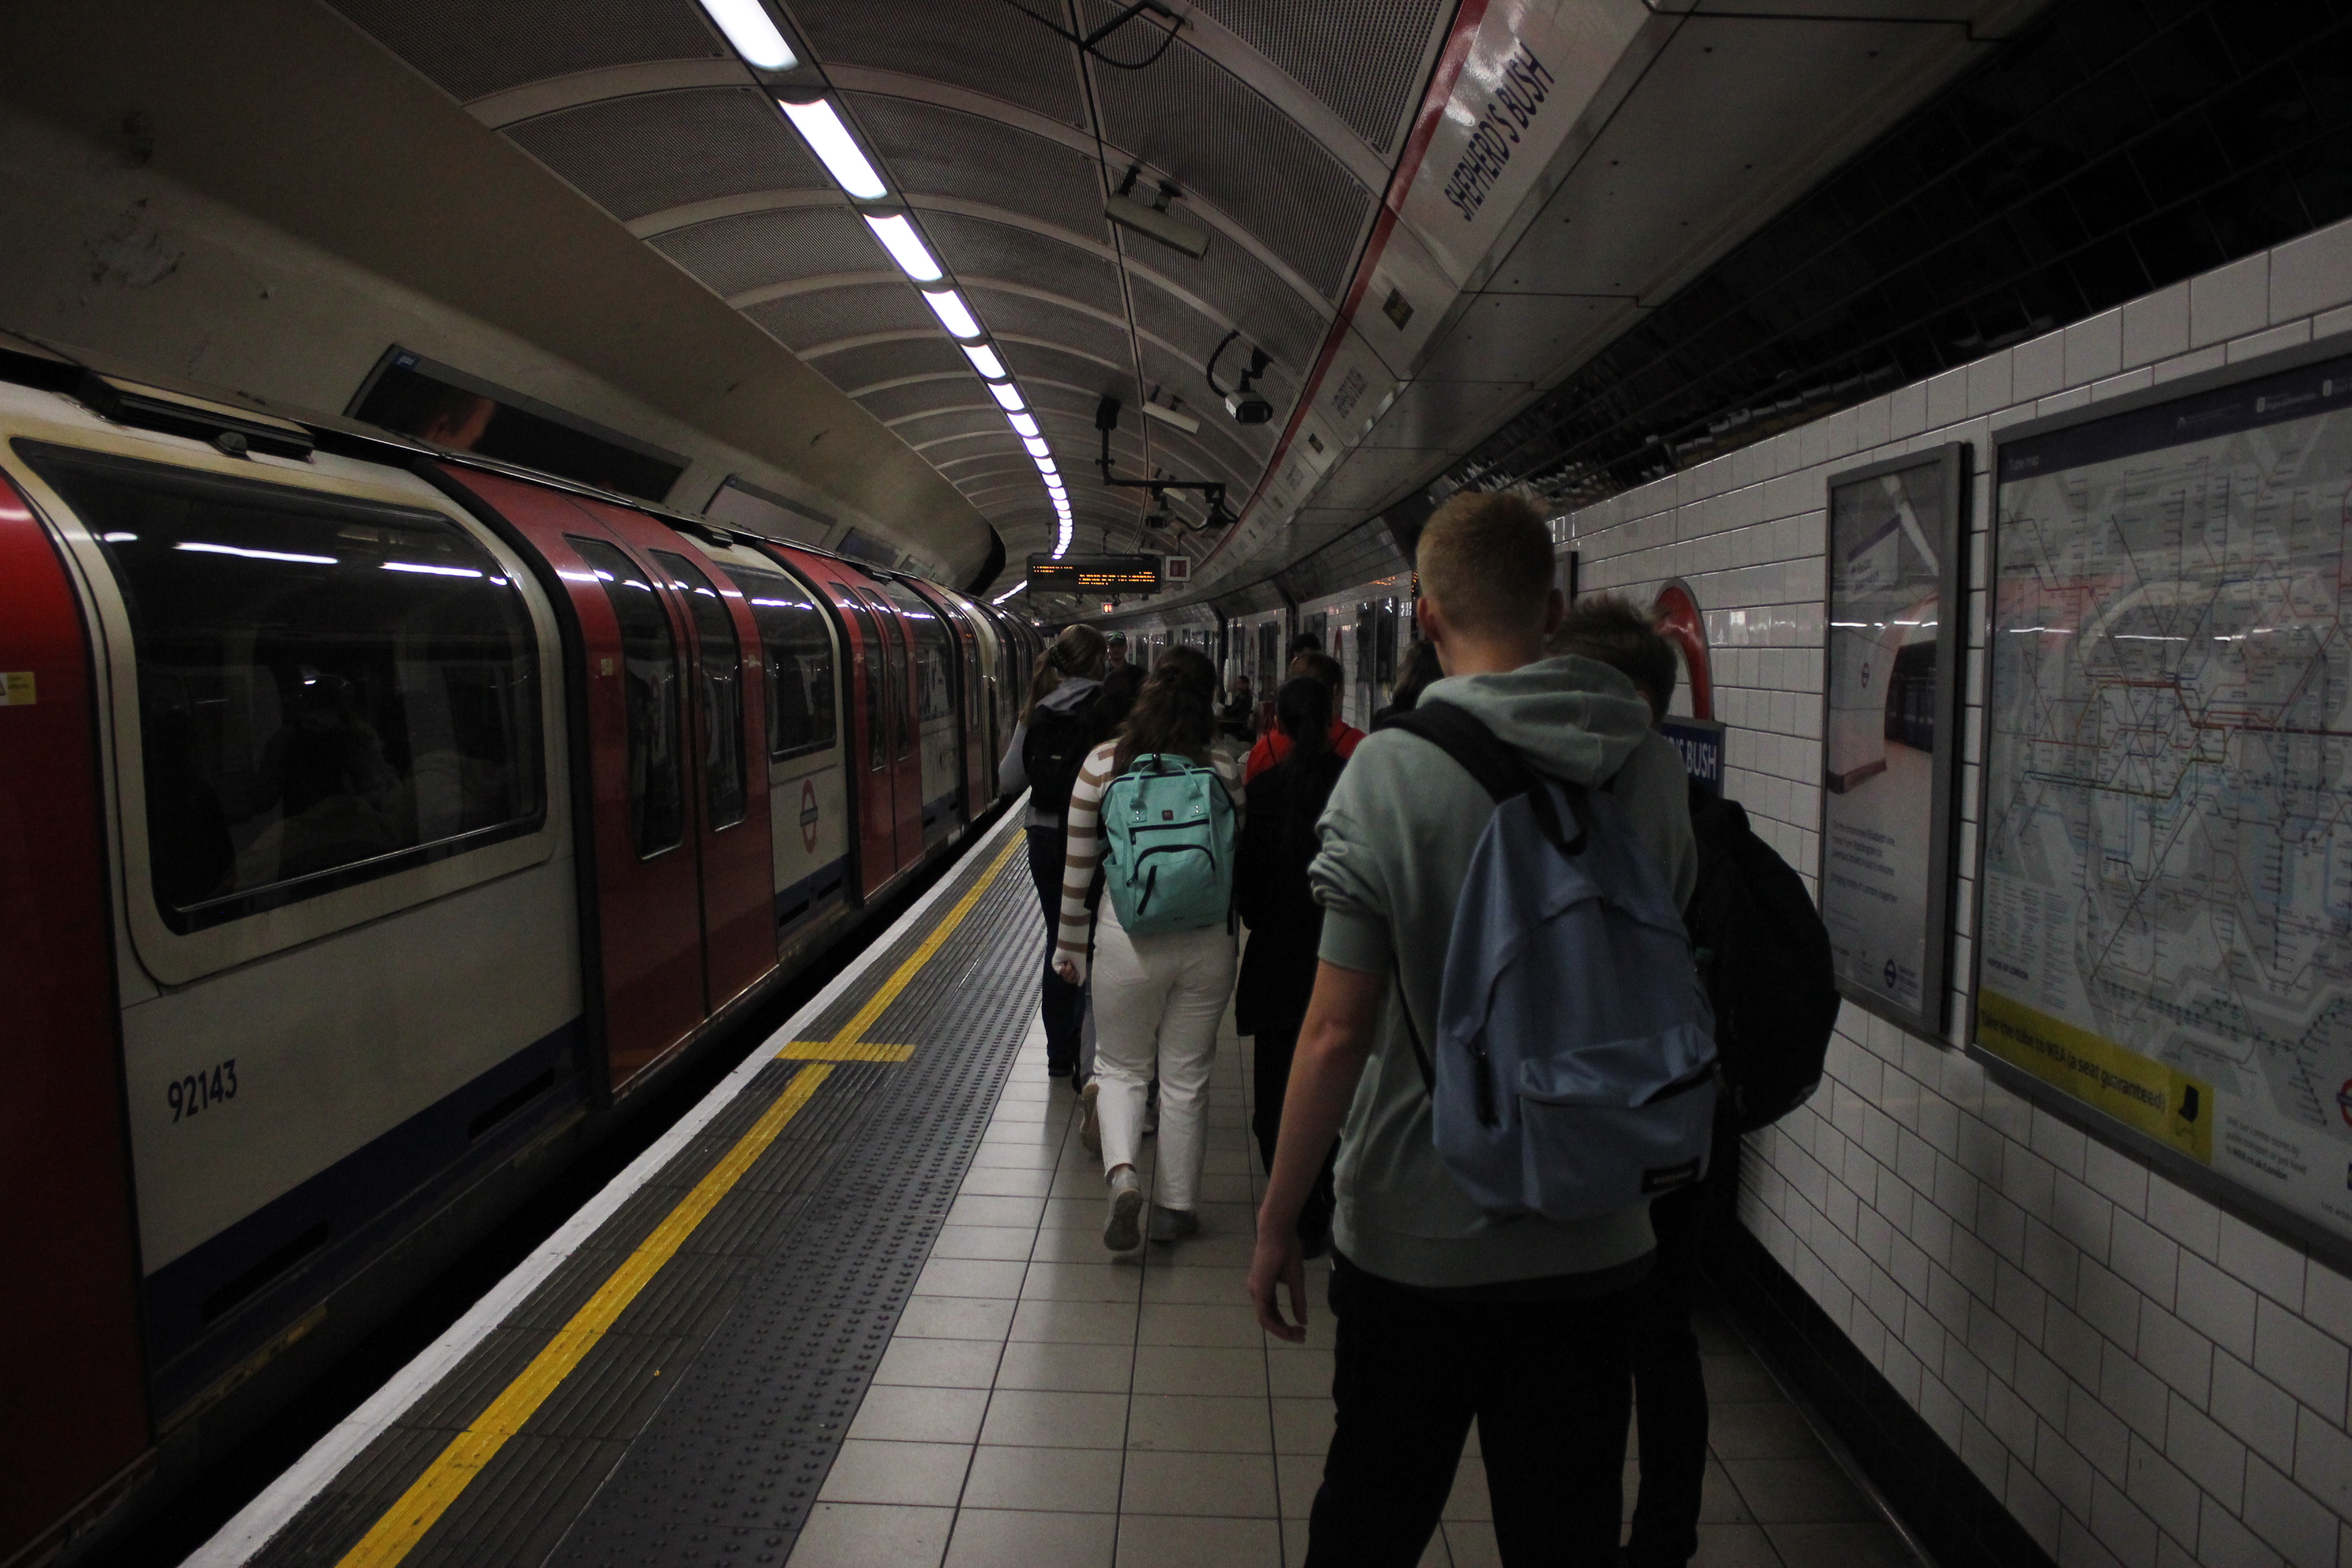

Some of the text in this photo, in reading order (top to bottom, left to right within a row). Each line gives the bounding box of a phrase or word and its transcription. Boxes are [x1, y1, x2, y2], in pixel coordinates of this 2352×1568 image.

[1444, 40, 1555, 223] SHEPHERD'S BUSH
[1686, 740, 1717, 781] BUSH
[167, 1058, 238, 1123] 92143
[2035, 1038, 2045, 1054] to
[2046, 1041, 2066, 1063] IKEA
[2067, 1051, 2077, 1071] (a
[2078, 1058, 2100, 1079] seat
[2100, 1068, 2166, 1113] guaranteed)
